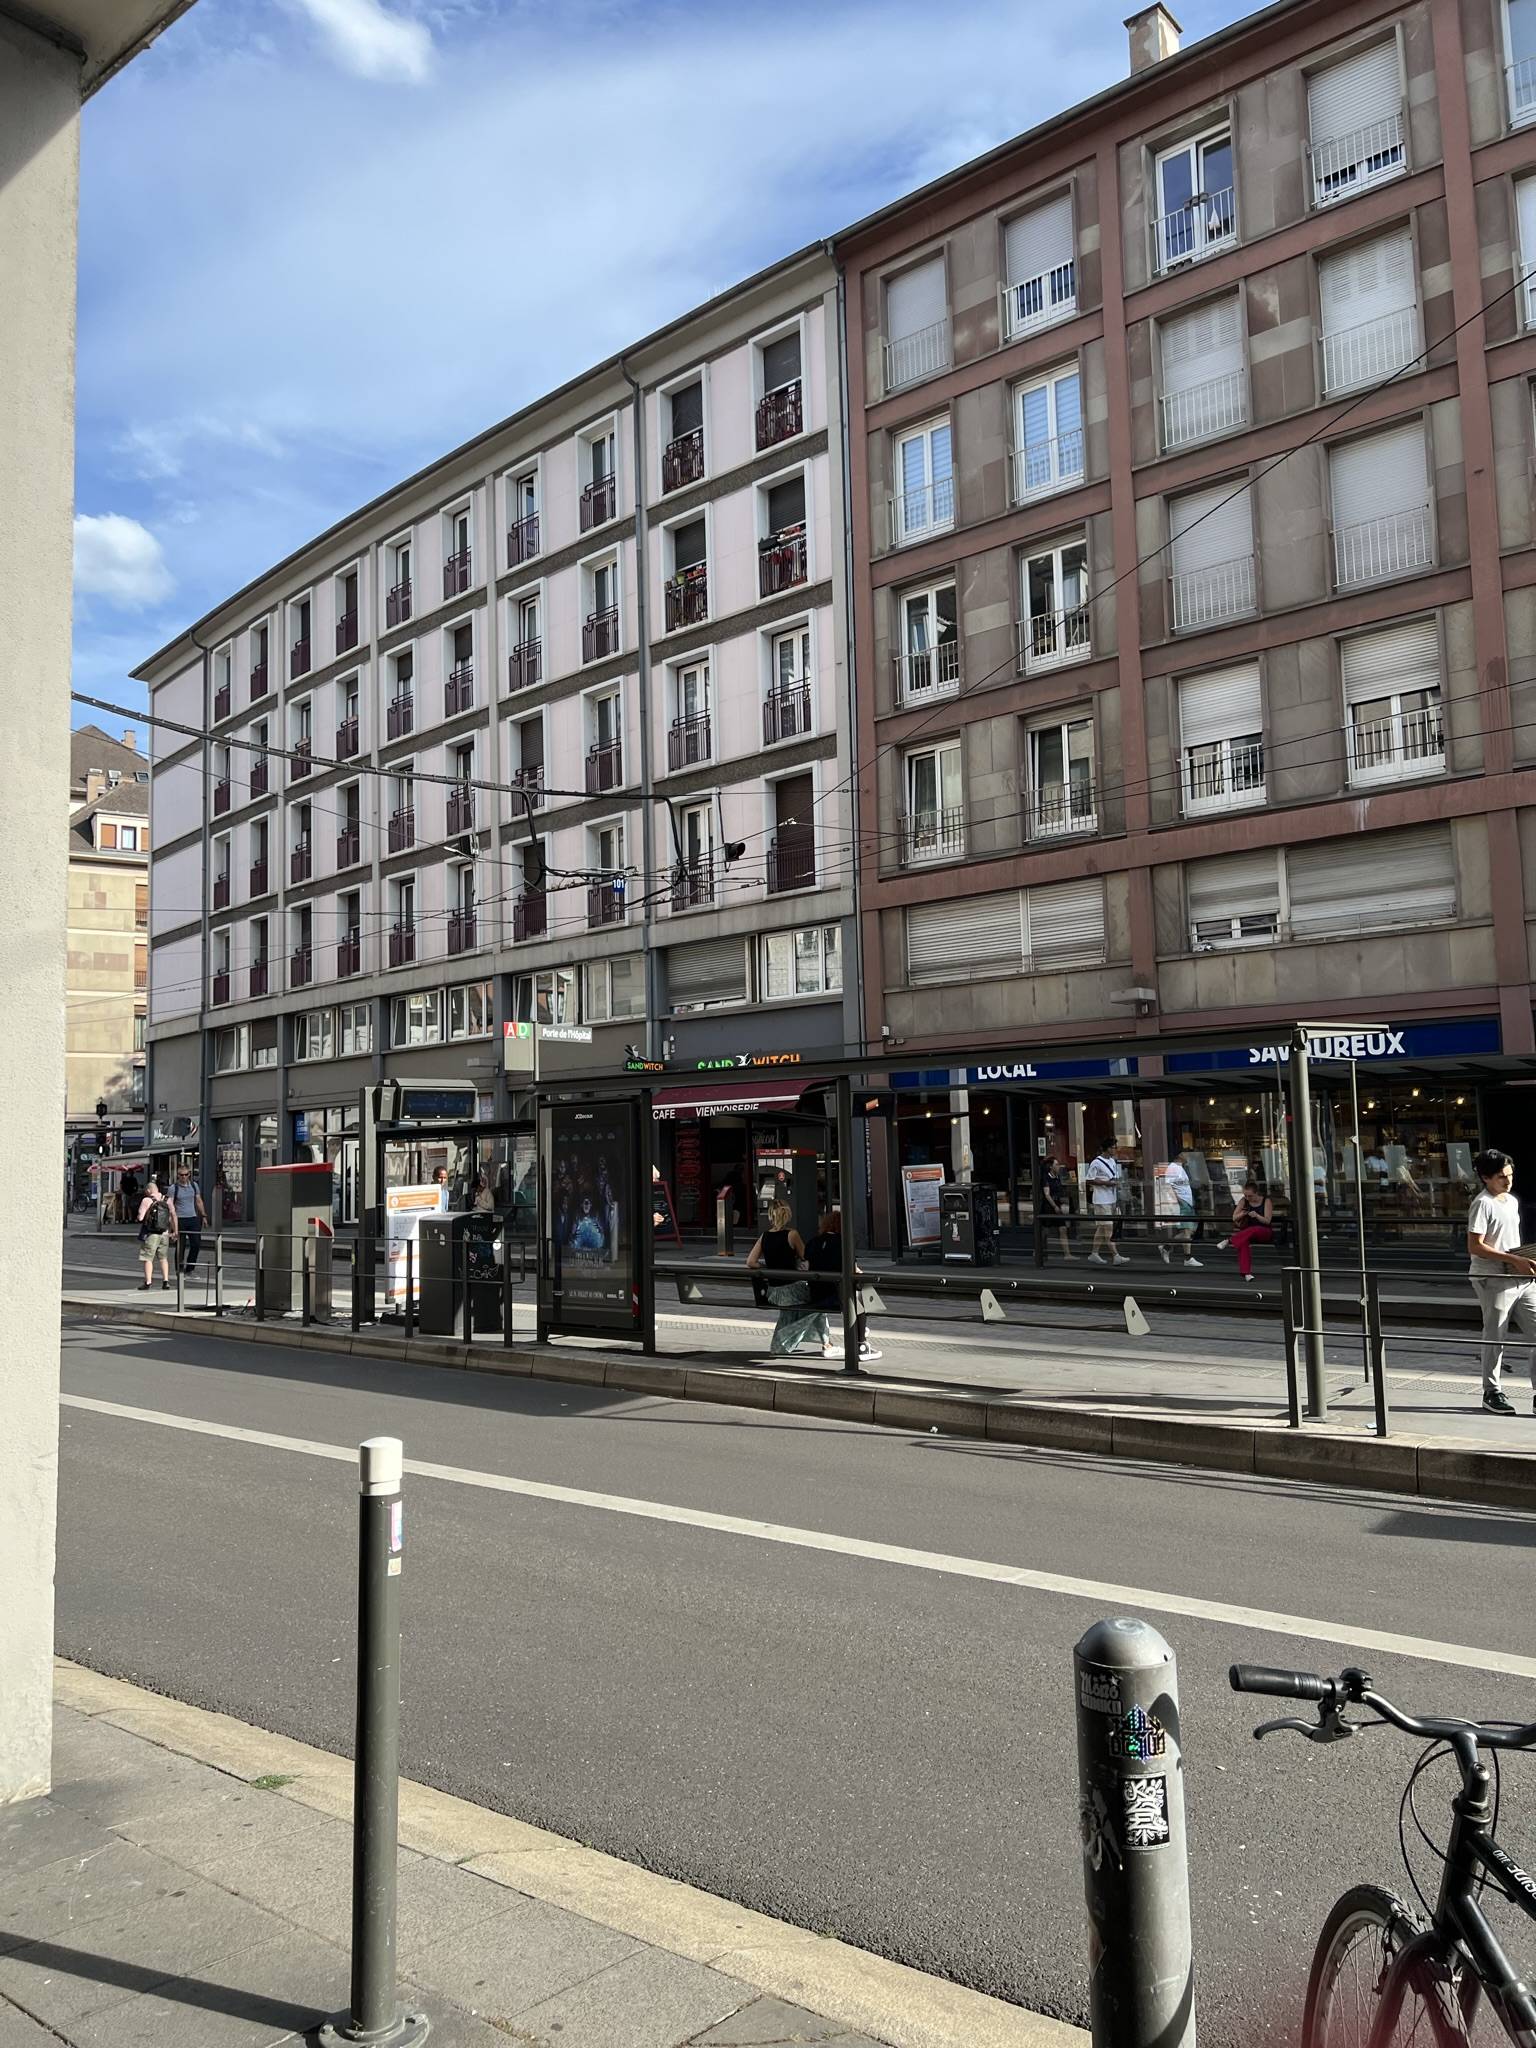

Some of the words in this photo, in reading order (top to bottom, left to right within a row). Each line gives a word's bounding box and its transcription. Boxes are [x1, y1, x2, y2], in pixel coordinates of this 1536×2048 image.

[612, 879, 624, 889] 101
[506, 1022, 517, 1036] A
[519, 1022, 528, 1036] D
[542, 1027, 559, 1038] Porte
[559, 1028, 567, 1039] de
[567, 1029, 592, 1041] l'Hôpital
[977, 1063, 1037, 1080] LOCAL
[652, 1109, 676, 1120] CAFE
